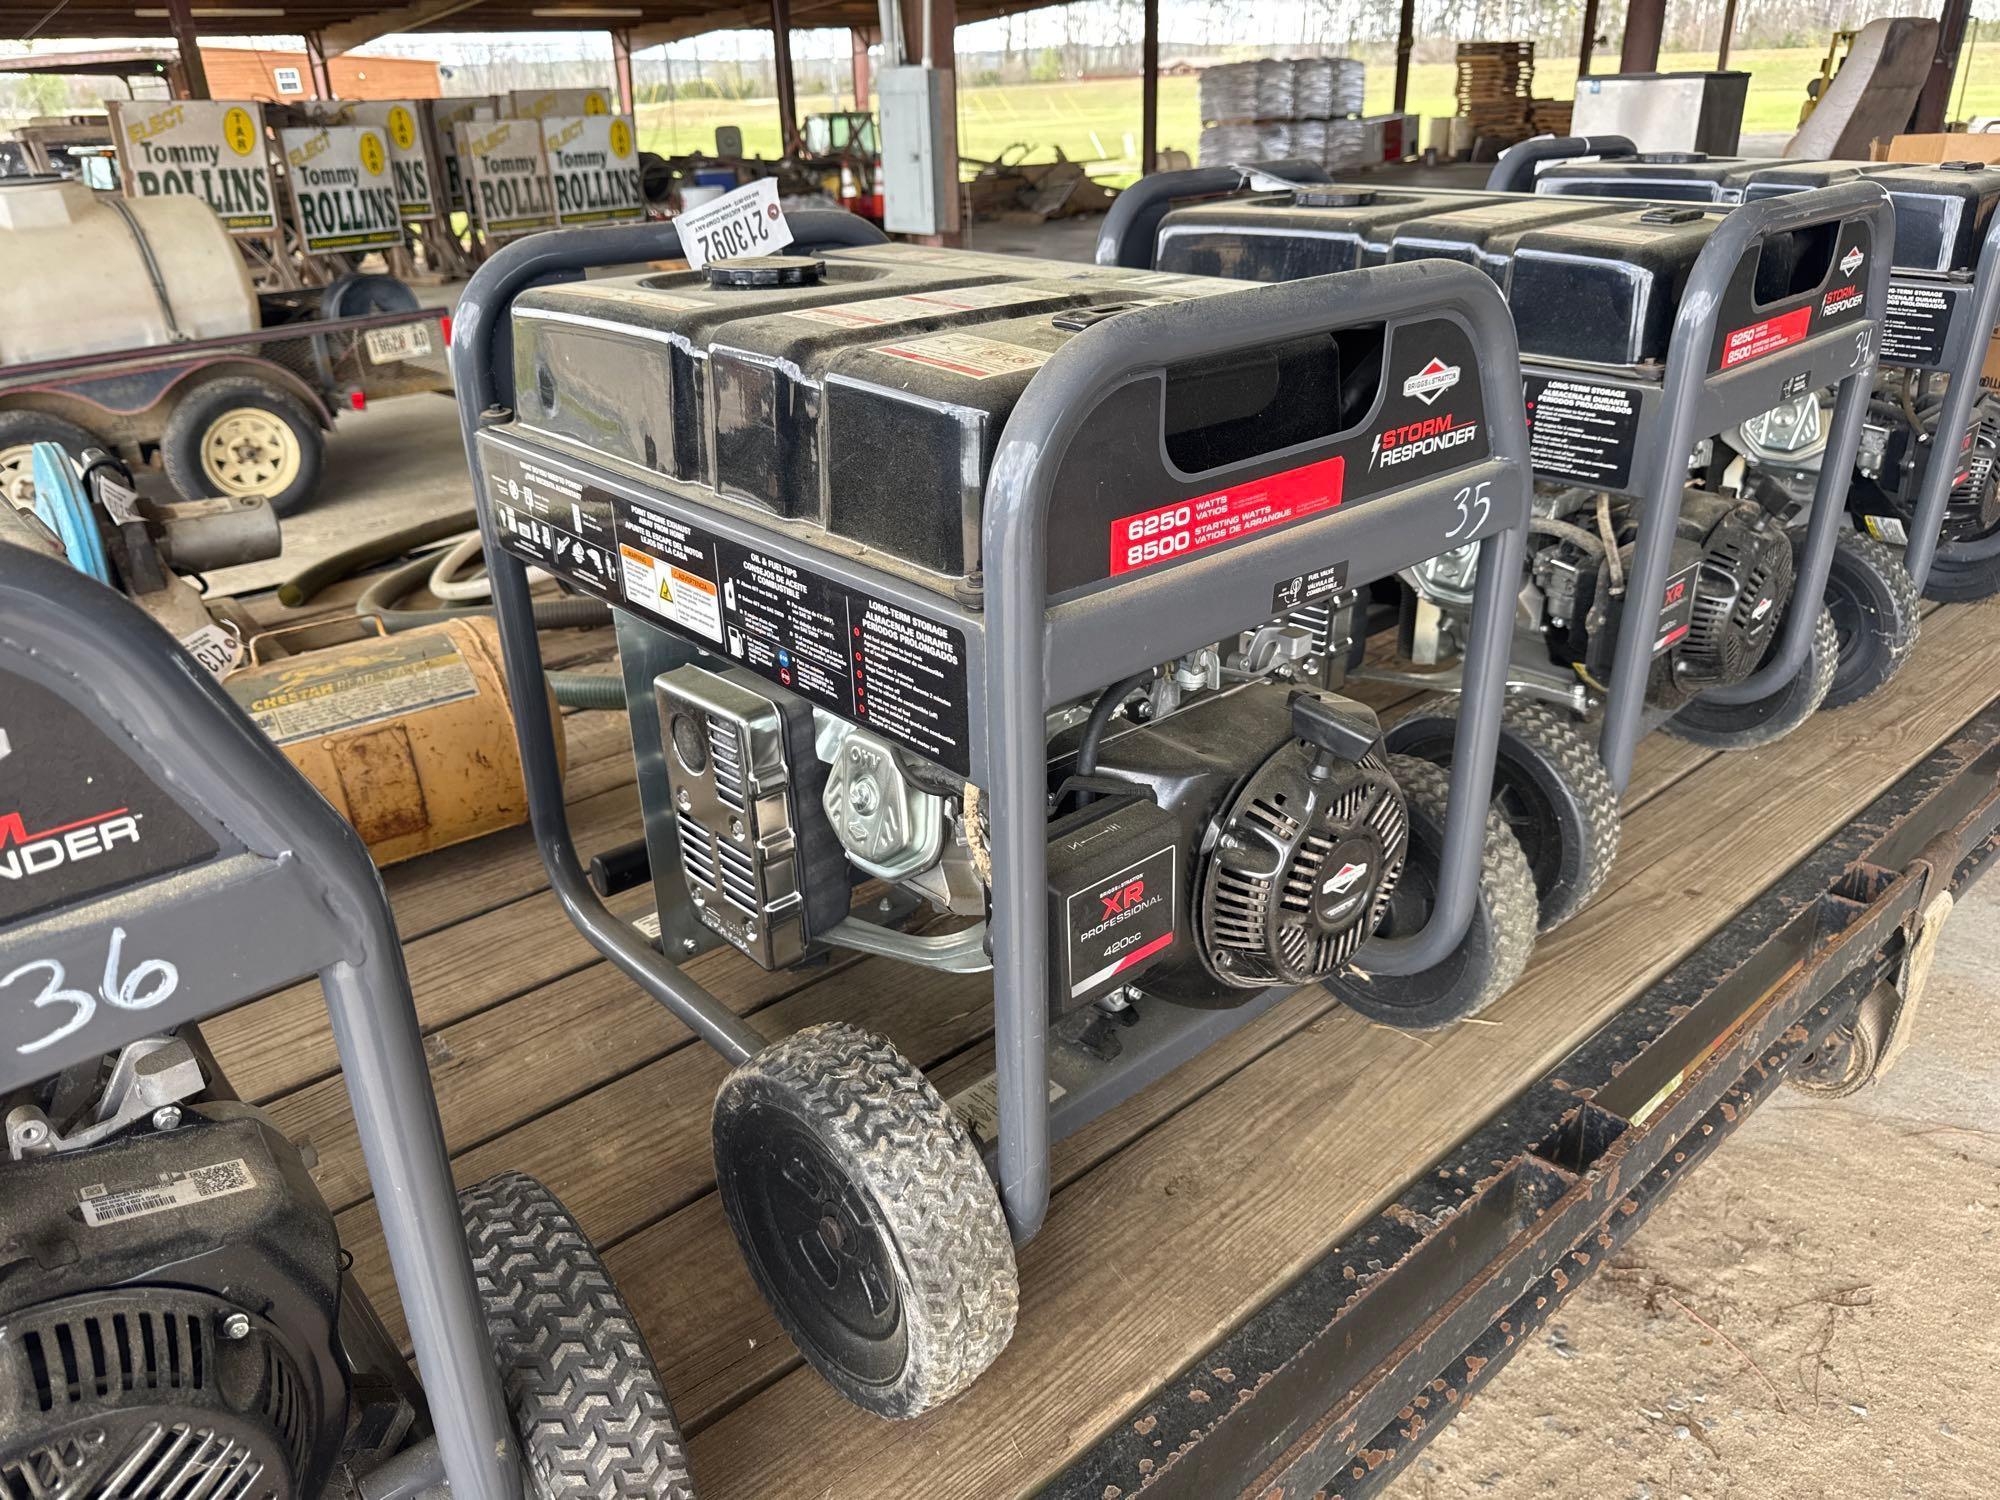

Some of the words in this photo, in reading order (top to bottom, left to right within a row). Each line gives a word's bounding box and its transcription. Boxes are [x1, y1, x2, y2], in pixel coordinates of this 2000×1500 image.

[127, 104, 184, 144] ELECT
[140, 141, 220, 166] Tommy
[481, 155, 538, 175] Tommy
[557, 150, 608, 168] Tommy
[299, 166, 359, 187] Tommy
[554, 168, 641, 211] ROLLINS
[298, 187, 397, 234] ROLLINS
[697, 210, 769, 263] 213092
[1823, 294, 1864, 317] RESPONDER
[1827, 284, 1855, 303] STORM
[1727, 345, 1751, 364] 8500
[1850, 328, 1872, 368] 34
[1542, 388, 1591, 402] ALMACENAJE
[1592, 396, 1629, 408] DURANTE
[1548, 381, 1590, 394] LONG-TERM
[1591, 387, 1626, 398] STORAGE
[1575, 400, 1632, 415] PROLONGADOS
[1382, 413, 1453, 450] STORM
[1380, 426, 1476, 468] RESPONDER
[1128, 506, 1191, 541] 6250
[1196, 495, 1227, 512] WATTS
[1196, 505, 1228, 521] VATIOS
[1445, 481, 1492, 539] 35
[652, 532, 672, 546] ESCAPE
[672, 540, 683, 551] DEL
[666, 519, 691, 536] EXHAUST
[1127, 531, 1190, 565] 8500
[1194, 516, 1239, 536] STARTING
[1242, 505, 1271, 520] WATTS
[1194, 530, 1226, 545] VATIOS
[1229, 525, 1241, 534] DE
[1244, 508, 1292, 530] ARRANQUE
[743, 561, 775, 581] CONSEJOS
[776, 573, 784, 585] DE
[786, 578, 808, 594] ACEITE
[751, 553, 761, 564] OIL
[762, 558, 767, 567] &
[768, 560, 782, 573] FUEL
[784, 566, 798, 579] TIPS
[752, 573, 756, 582] Y
[758, 575, 800, 600] COMBUSTIBLE
[1664, 583, 1685, 606] XR
[866, 610, 914, 638] ALMACENAJE
[916, 630, 953, 653] DURANTE
[869, 599, 910, 624] LONG-TERM
[912, 616, 948, 639] STORAGE
[197, 644, 232, 674] 213
[900, 634, 958, 666] PROLONGADOS
[251, 683, 334, 712] CHEETAH
[1101, 881, 1144, 921] XR
[1081, 894, 1163, 943] PROFESSIONAL
[1104, 932, 1142, 957] 420cc
[0, 927, 179, 1053] 36
